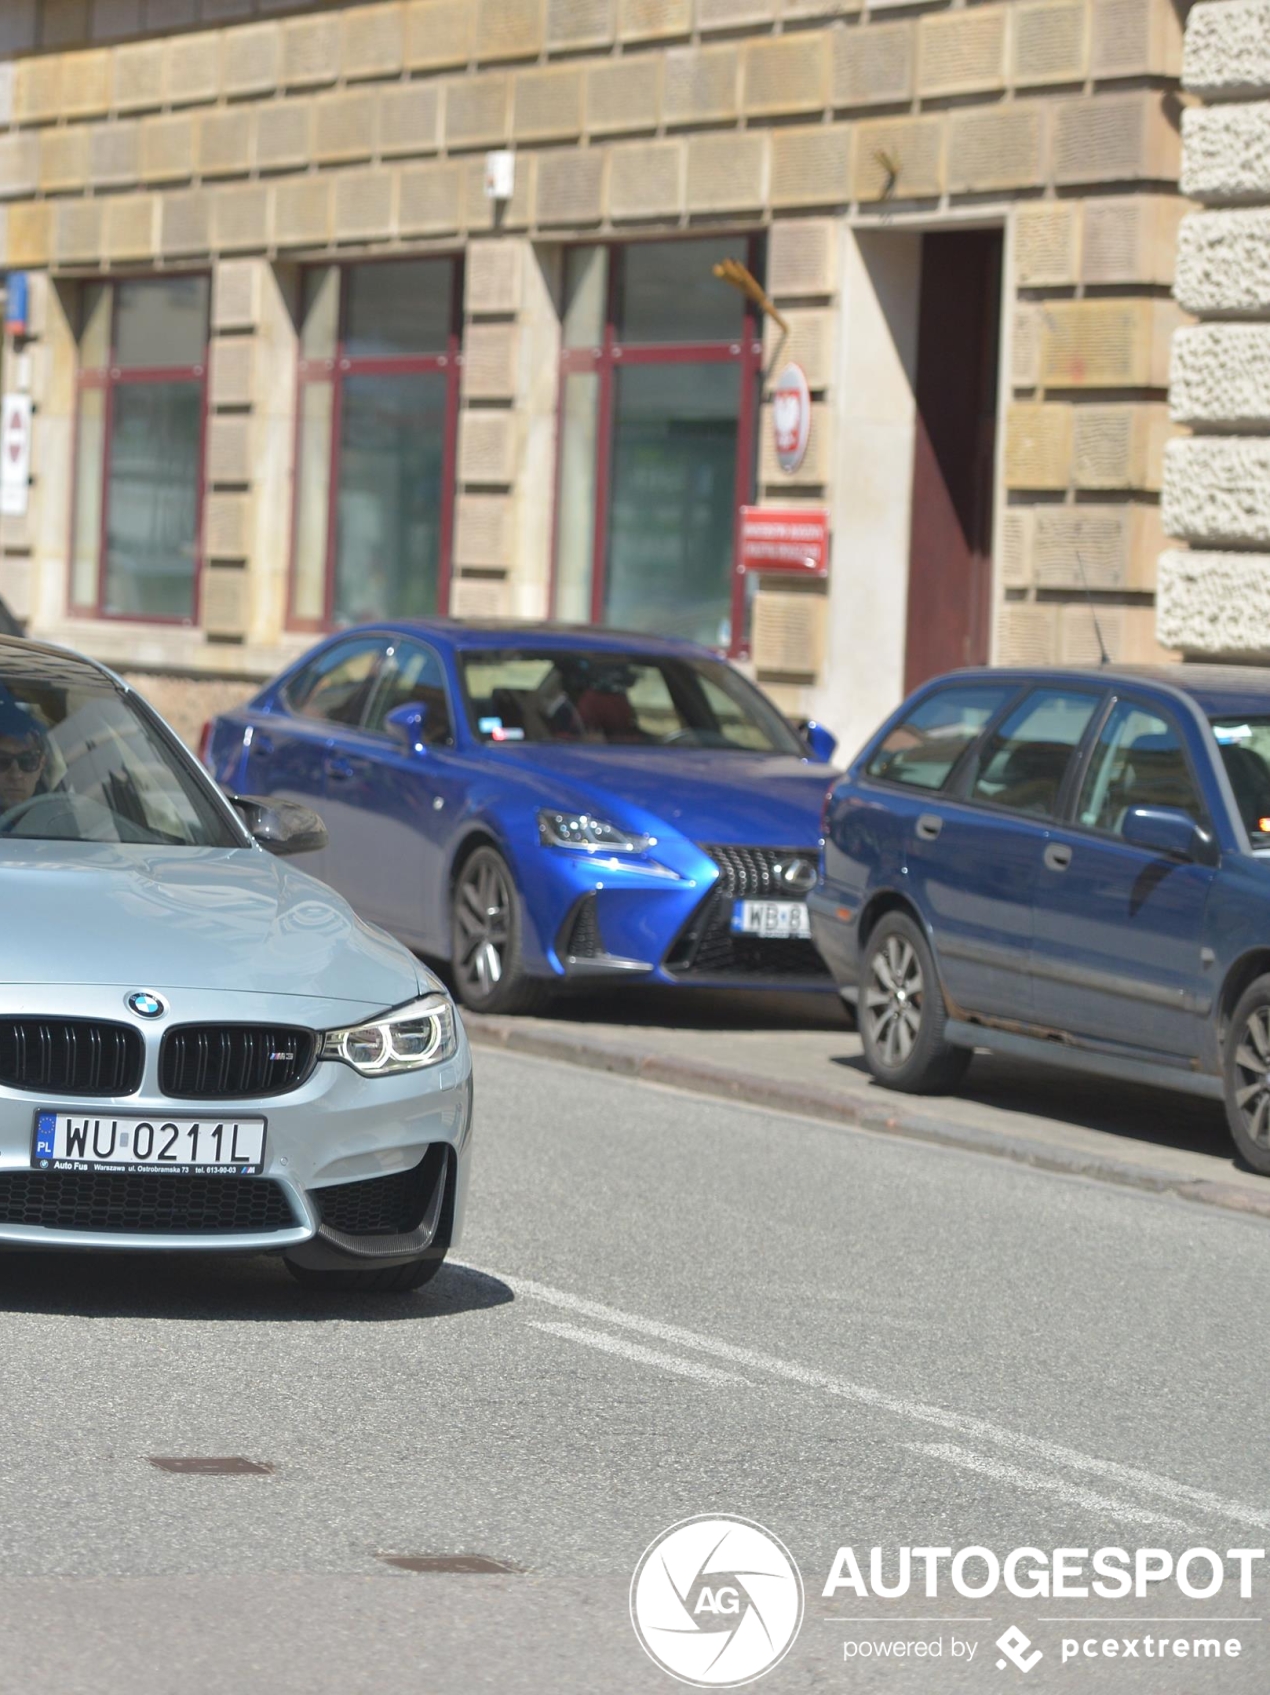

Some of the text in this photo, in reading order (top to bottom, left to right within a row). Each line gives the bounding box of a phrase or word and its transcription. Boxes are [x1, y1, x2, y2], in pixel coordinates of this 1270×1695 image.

[750, 904, 778, 931] WB
[37, 1141, 52, 1153] PL
[65, 1118, 251, 1163] WU 0211L
[53, 1160, 73, 1170] Auto
[74, 1161, 88, 1171] Fus
[93, 1163, 126, 1172] Warszawa
[137, 1165, 181, 1173] Ostrobramska
